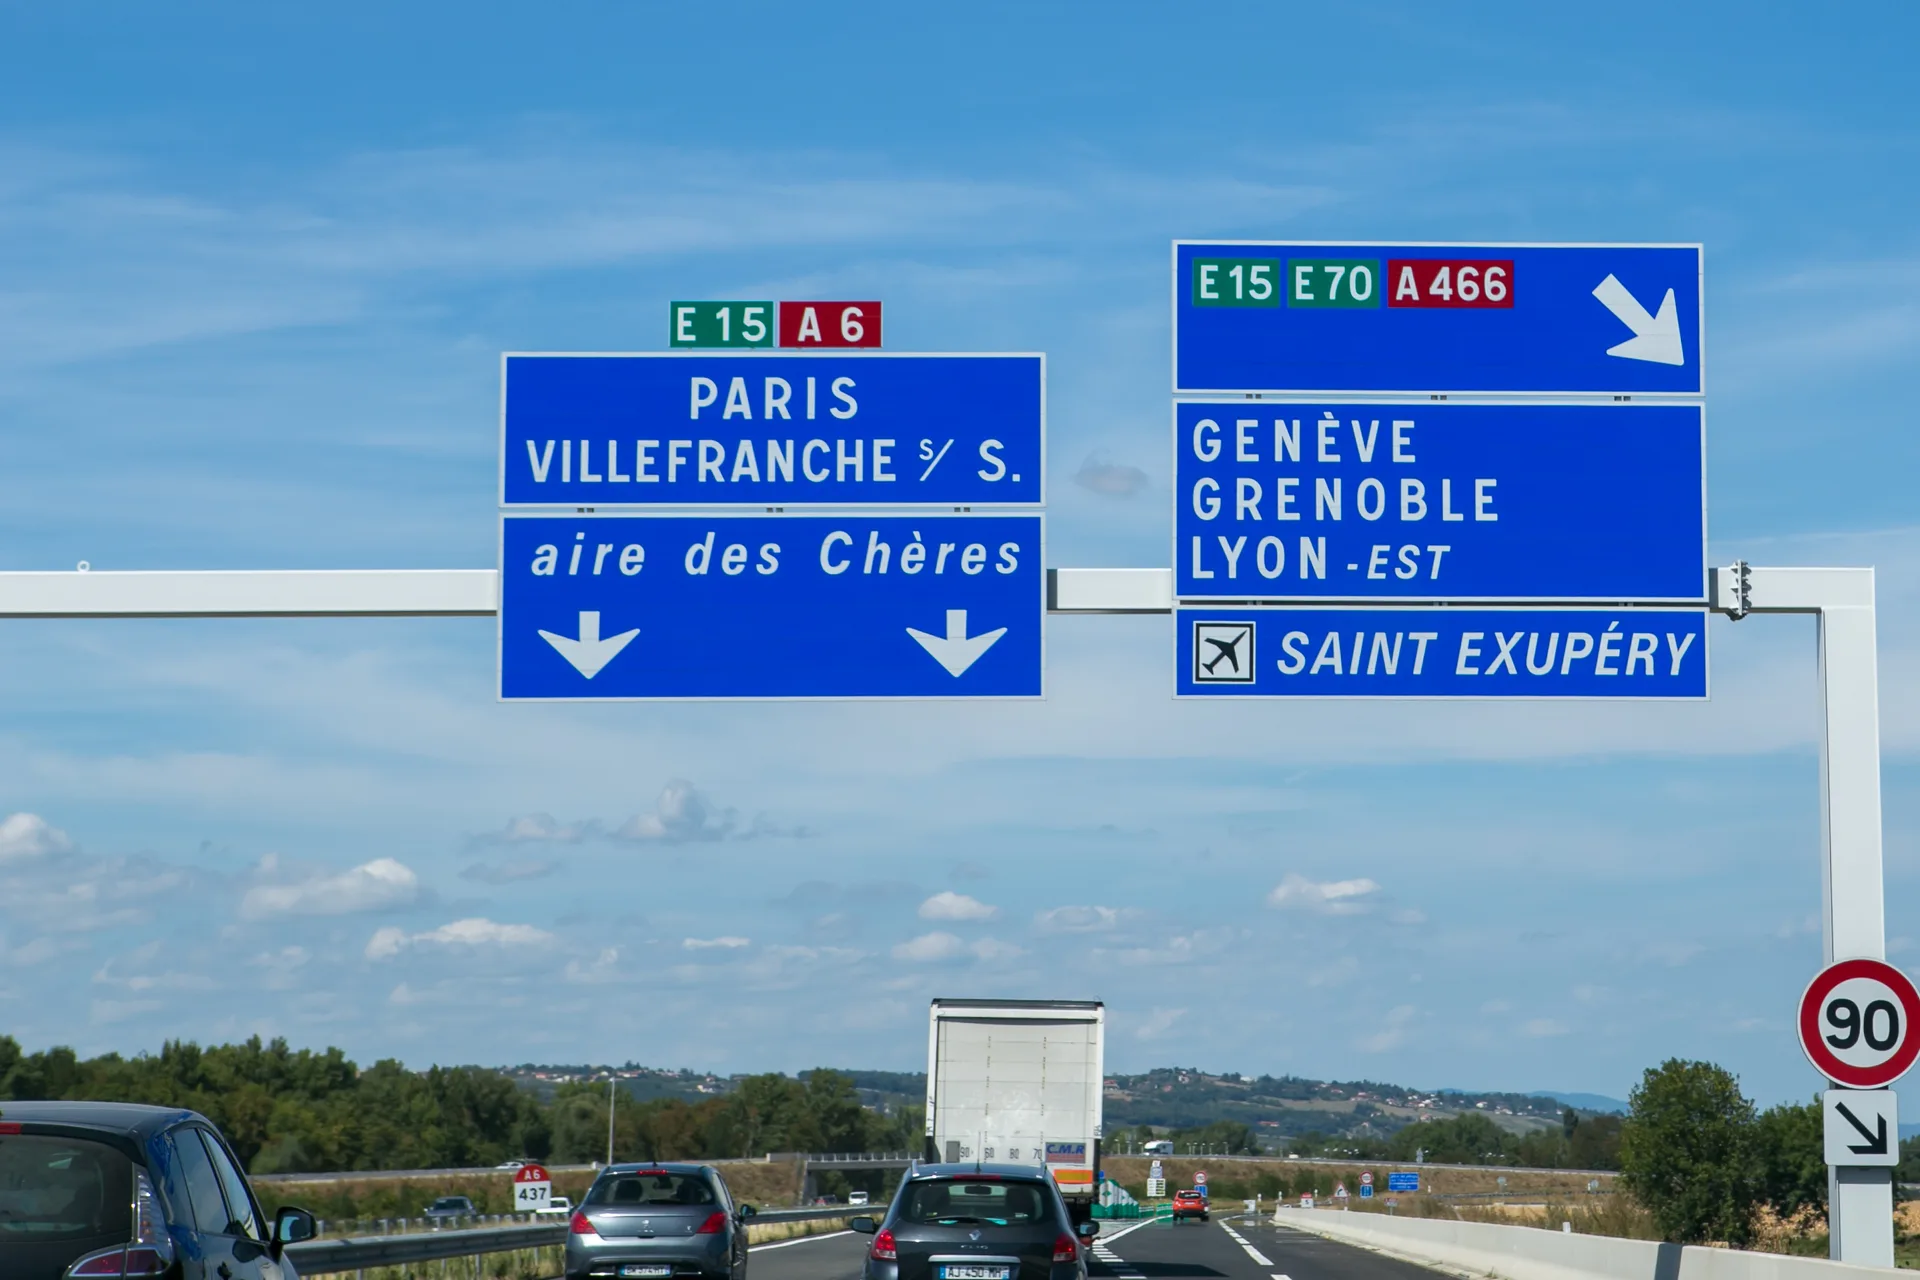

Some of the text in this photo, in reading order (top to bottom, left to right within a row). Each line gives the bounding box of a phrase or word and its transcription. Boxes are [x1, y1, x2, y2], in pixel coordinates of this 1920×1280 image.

[1200, 265, 1272, 300] E 15
[1295, 266, 1372, 301] E 70
[1395, 266, 1507, 302] A 466
[677, 307, 766, 342] E 15
[797, 306, 865, 342] A 6
[690, 376, 858, 420] PARIS
[1193, 411, 1416, 463] GENÈVE
[526, 438, 896, 483] VILLEFRANCHE
[977, 438, 1021, 483] S.
[1192, 477, 1499, 522] GRENOBLE
[531, 530, 1021, 576] aire des Chères
[1192, 535, 1327, 580] LYON
[1277, 620, 1697, 677] SAINT EXUPÉRY
[1826, 998, 1899, 1051] 90
[519, 1187, 547, 1201] 437
[524, 1168, 541, 1180] A 6
